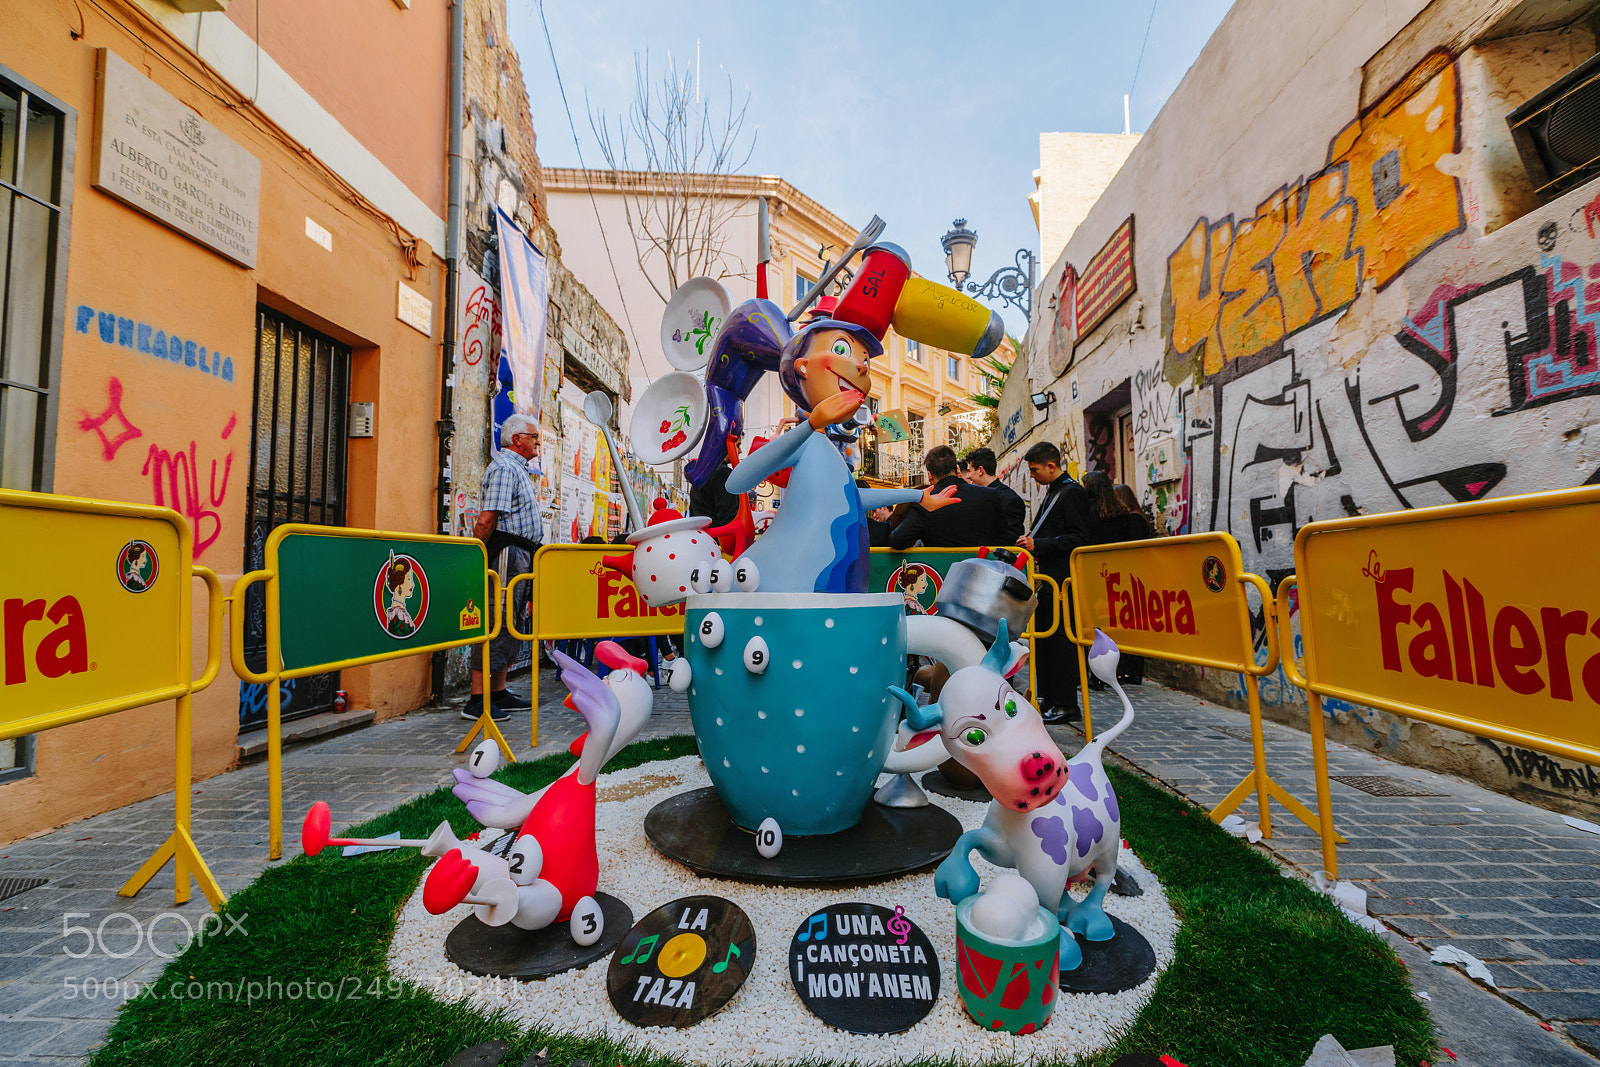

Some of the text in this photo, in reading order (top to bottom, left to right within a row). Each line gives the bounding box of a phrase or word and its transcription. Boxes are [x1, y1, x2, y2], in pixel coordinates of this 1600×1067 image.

[125, 113, 138, 128] EN
[142, 124, 163, 146] ESTA
[165, 141, 187, 162] CASA
[110, 138, 168, 181] ALBERTO
[218, 202, 255, 234] ESTEVE
[120, 163, 246, 243] LLUITADOR PER LES LLIBERTATS
[119, 176, 142, 195] PELS
[144, 190, 172, 213] DRETS
[174, 207, 195, 226] DELS
[197, 220, 251, 257] TREBALLADORS
[862, 269, 886, 299] SAL
[76, 305, 234, 383] FUNKADELIA
[1071, 381, 1079, 400] B
[690, 569, 747, 584] 4 5 6
[1362, 549, 1385, 582] La
[1105, 571, 1196, 635] Fallera
[701, 621, 713, 635] 8
[752, 650, 764, 665] 9
[756, 829, 775, 847] 10
[509, 853, 525, 874] 2
[581, 912, 597, 935] 3
[677, 907, 709, 931] LA
[835, 914, 886, 936] UNA
[806, 944, 928, 968] CANÇONETA
[632, 975, 696, 1010] TAZA
[807, 972, 933, 1001] MON'ANEM
